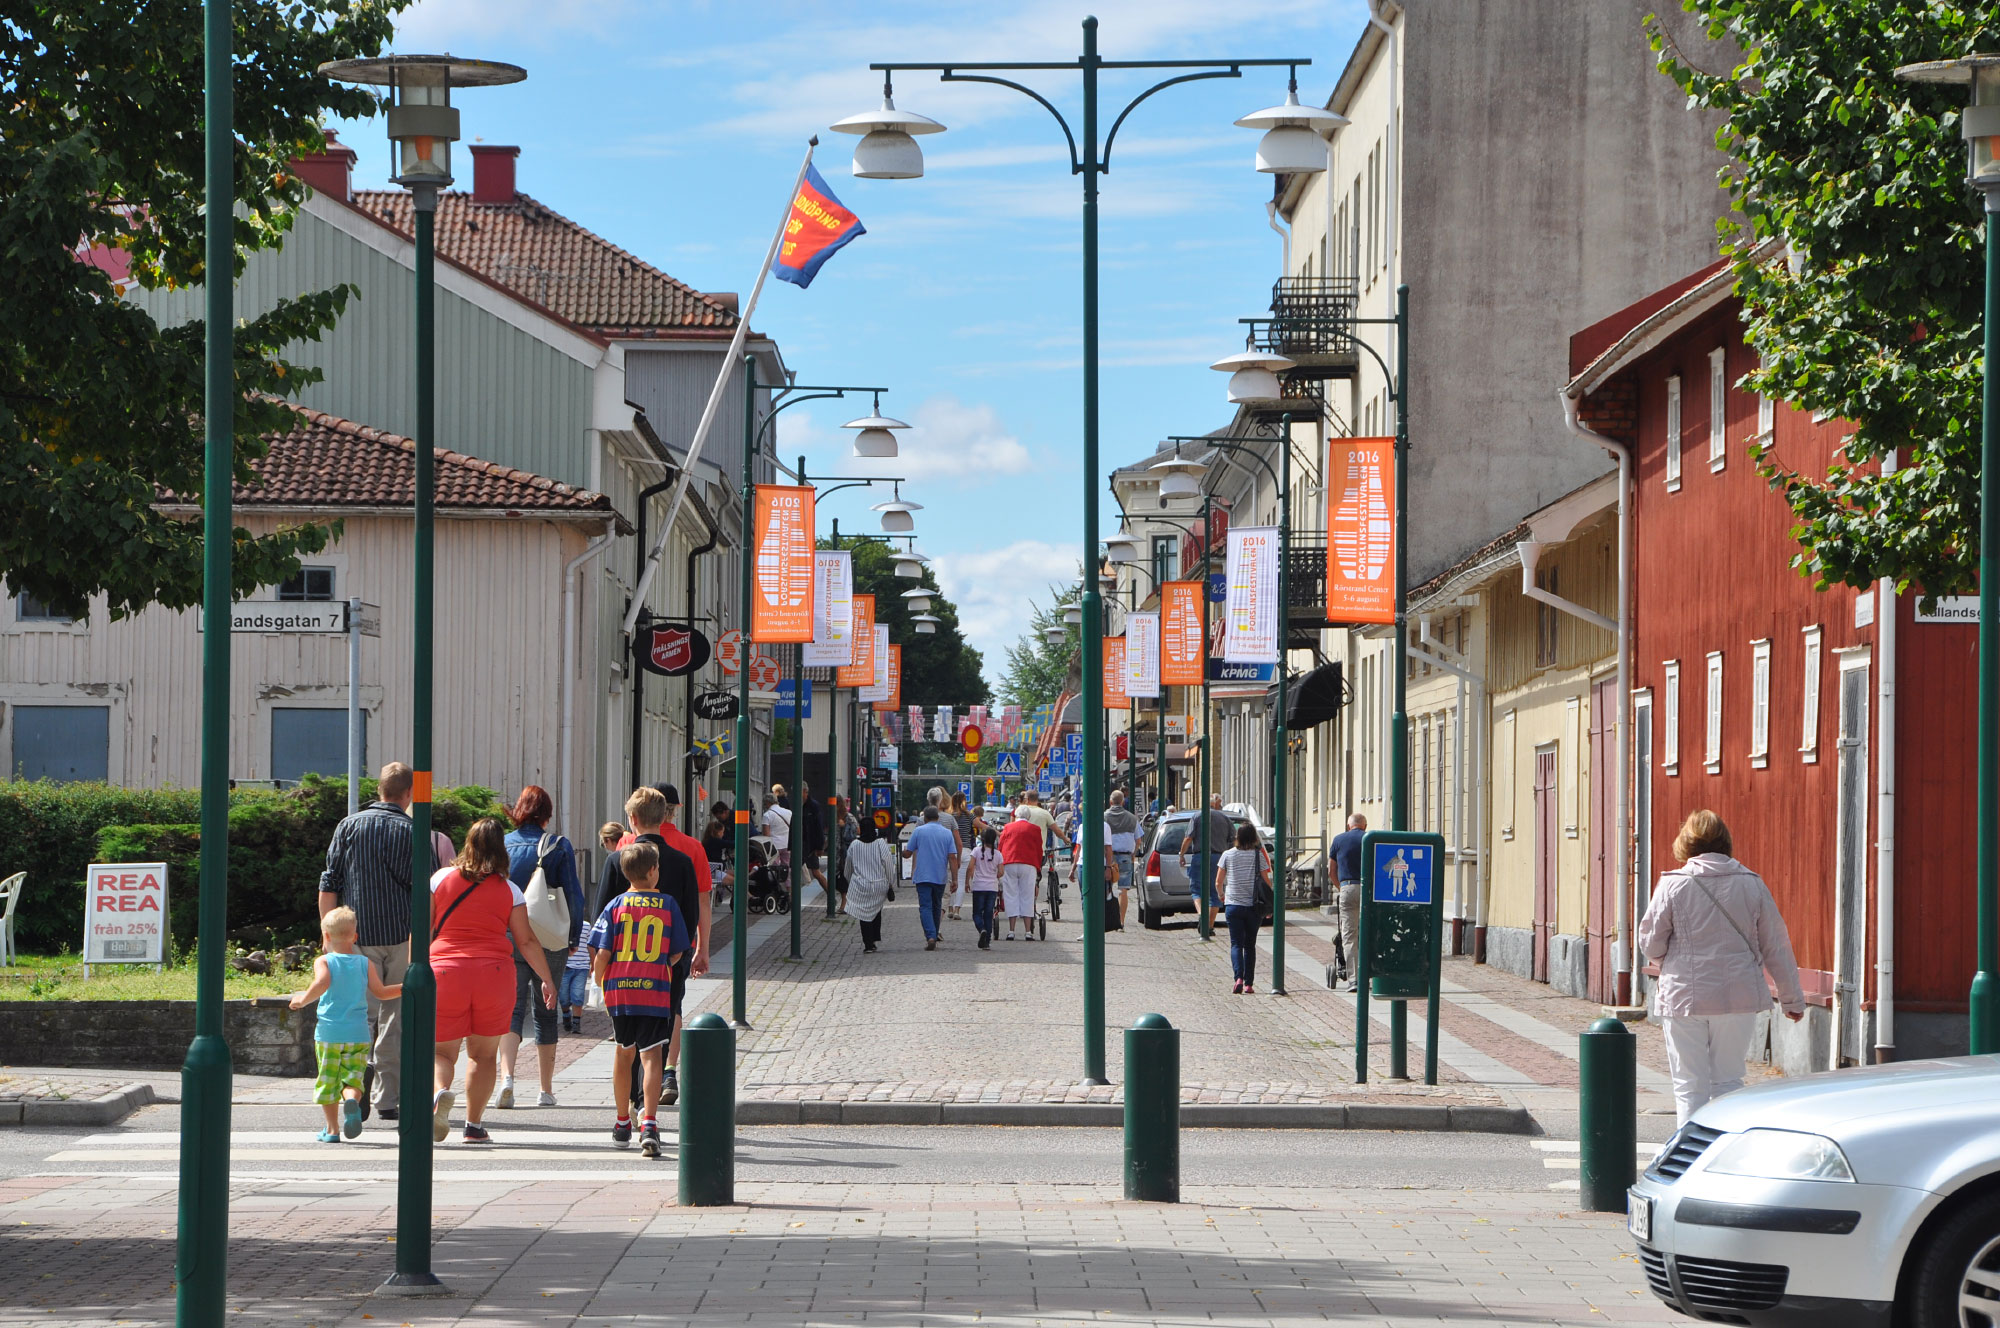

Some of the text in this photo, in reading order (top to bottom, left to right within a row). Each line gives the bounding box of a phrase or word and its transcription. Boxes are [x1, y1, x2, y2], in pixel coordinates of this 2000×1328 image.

[1348, 451, 1379, 463] 2016
[1358, 466, 1368, 580] PORSLINSFESTIVALEN
[1242, 537, 1266, 546] 2016
[1249, 547, 1257, 632] PORSLINSFESTIVALEN
[1334, 583, 1389, 593] Rörstrand Center
[329, 614, 339, 628] 7
[1220, 668, 1258, 679] KPMG
[97, 874, 160, 891] REA
[96, 895, 160, 912] REA
[623, 896, 664, 909] MESSI
[94, 923, 158, 935] från 25%
[616, 912, 664, 962] 10
[617, 979, 643, 989] unicef
